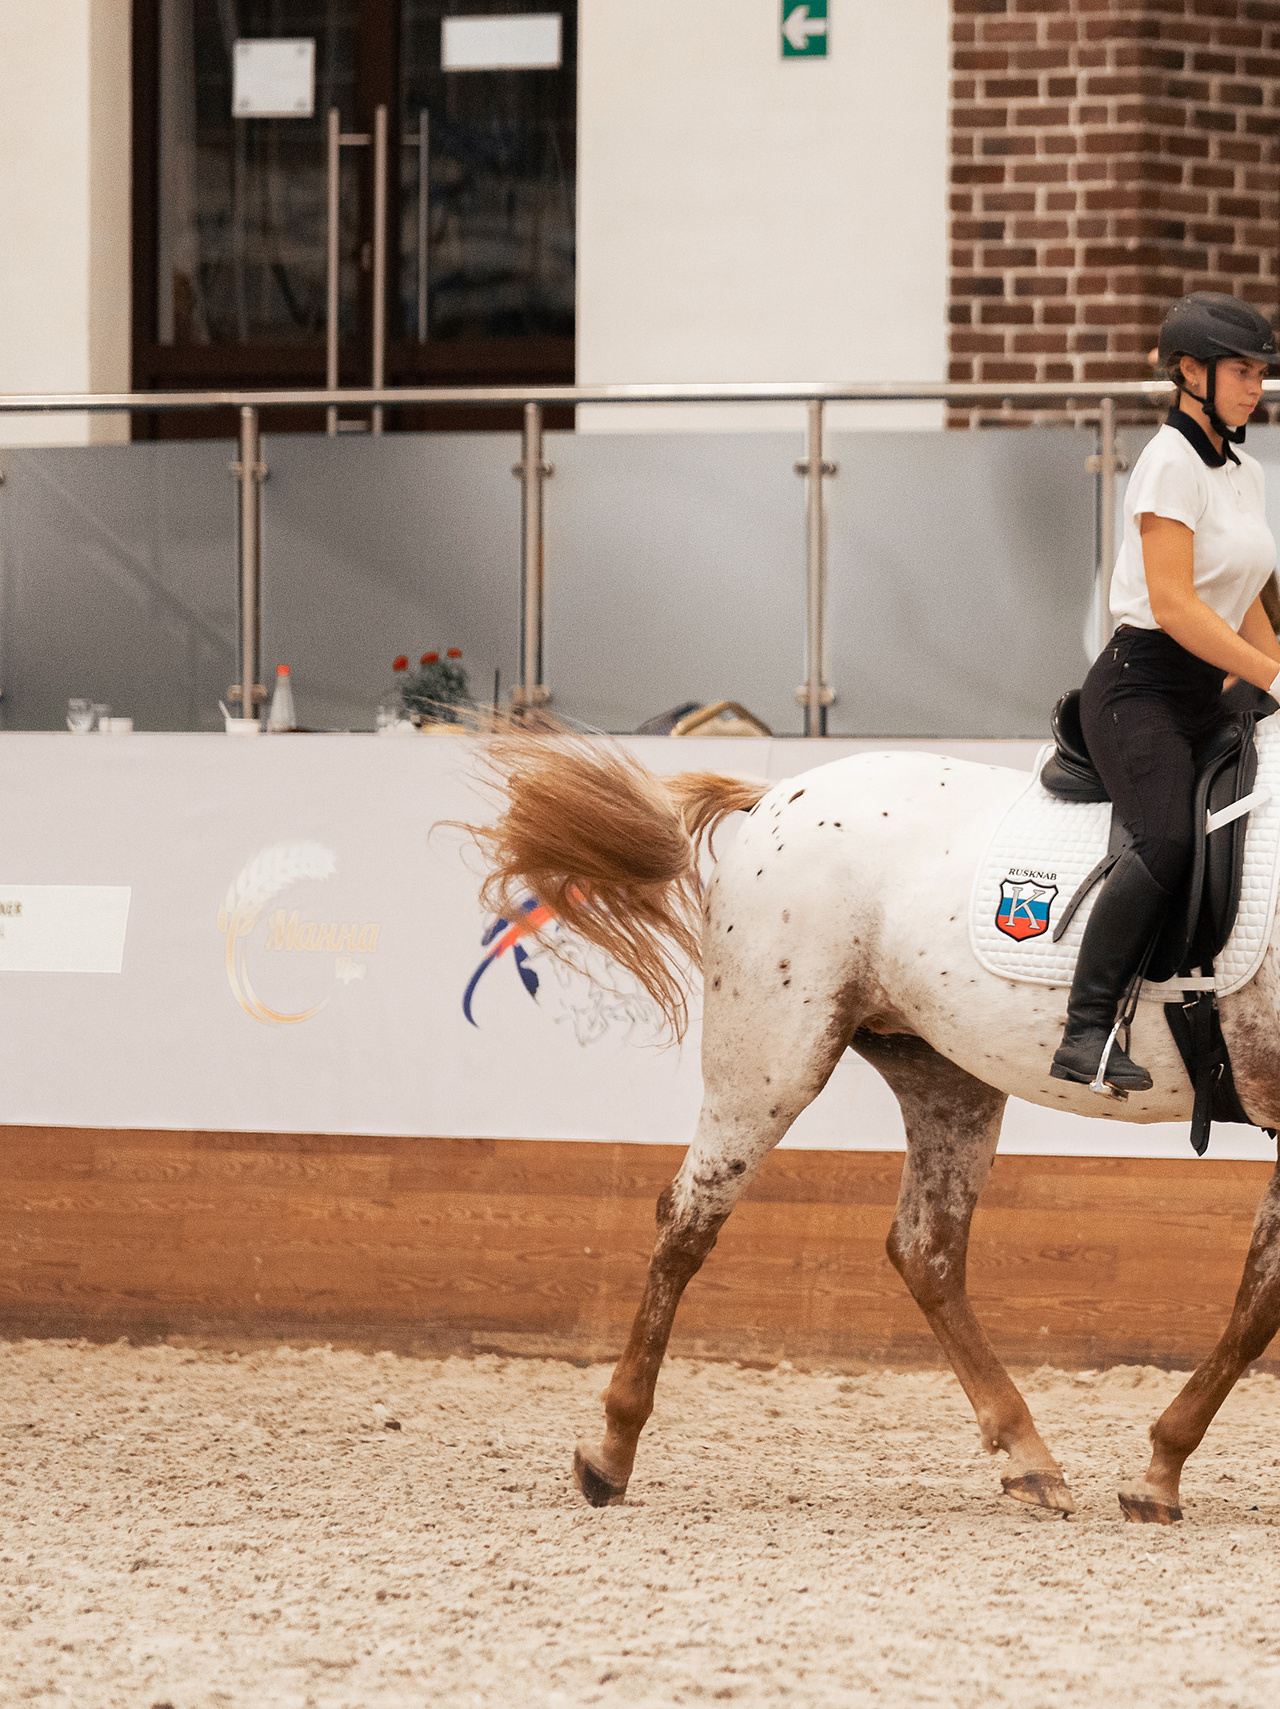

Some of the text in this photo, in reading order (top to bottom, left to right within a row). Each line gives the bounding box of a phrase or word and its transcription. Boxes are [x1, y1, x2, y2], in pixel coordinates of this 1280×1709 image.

[1008, 868, 1057, 881] RUSKNAB
[1005, 886, 1046, 930] K
[265, 908, 381, 953] Манна
